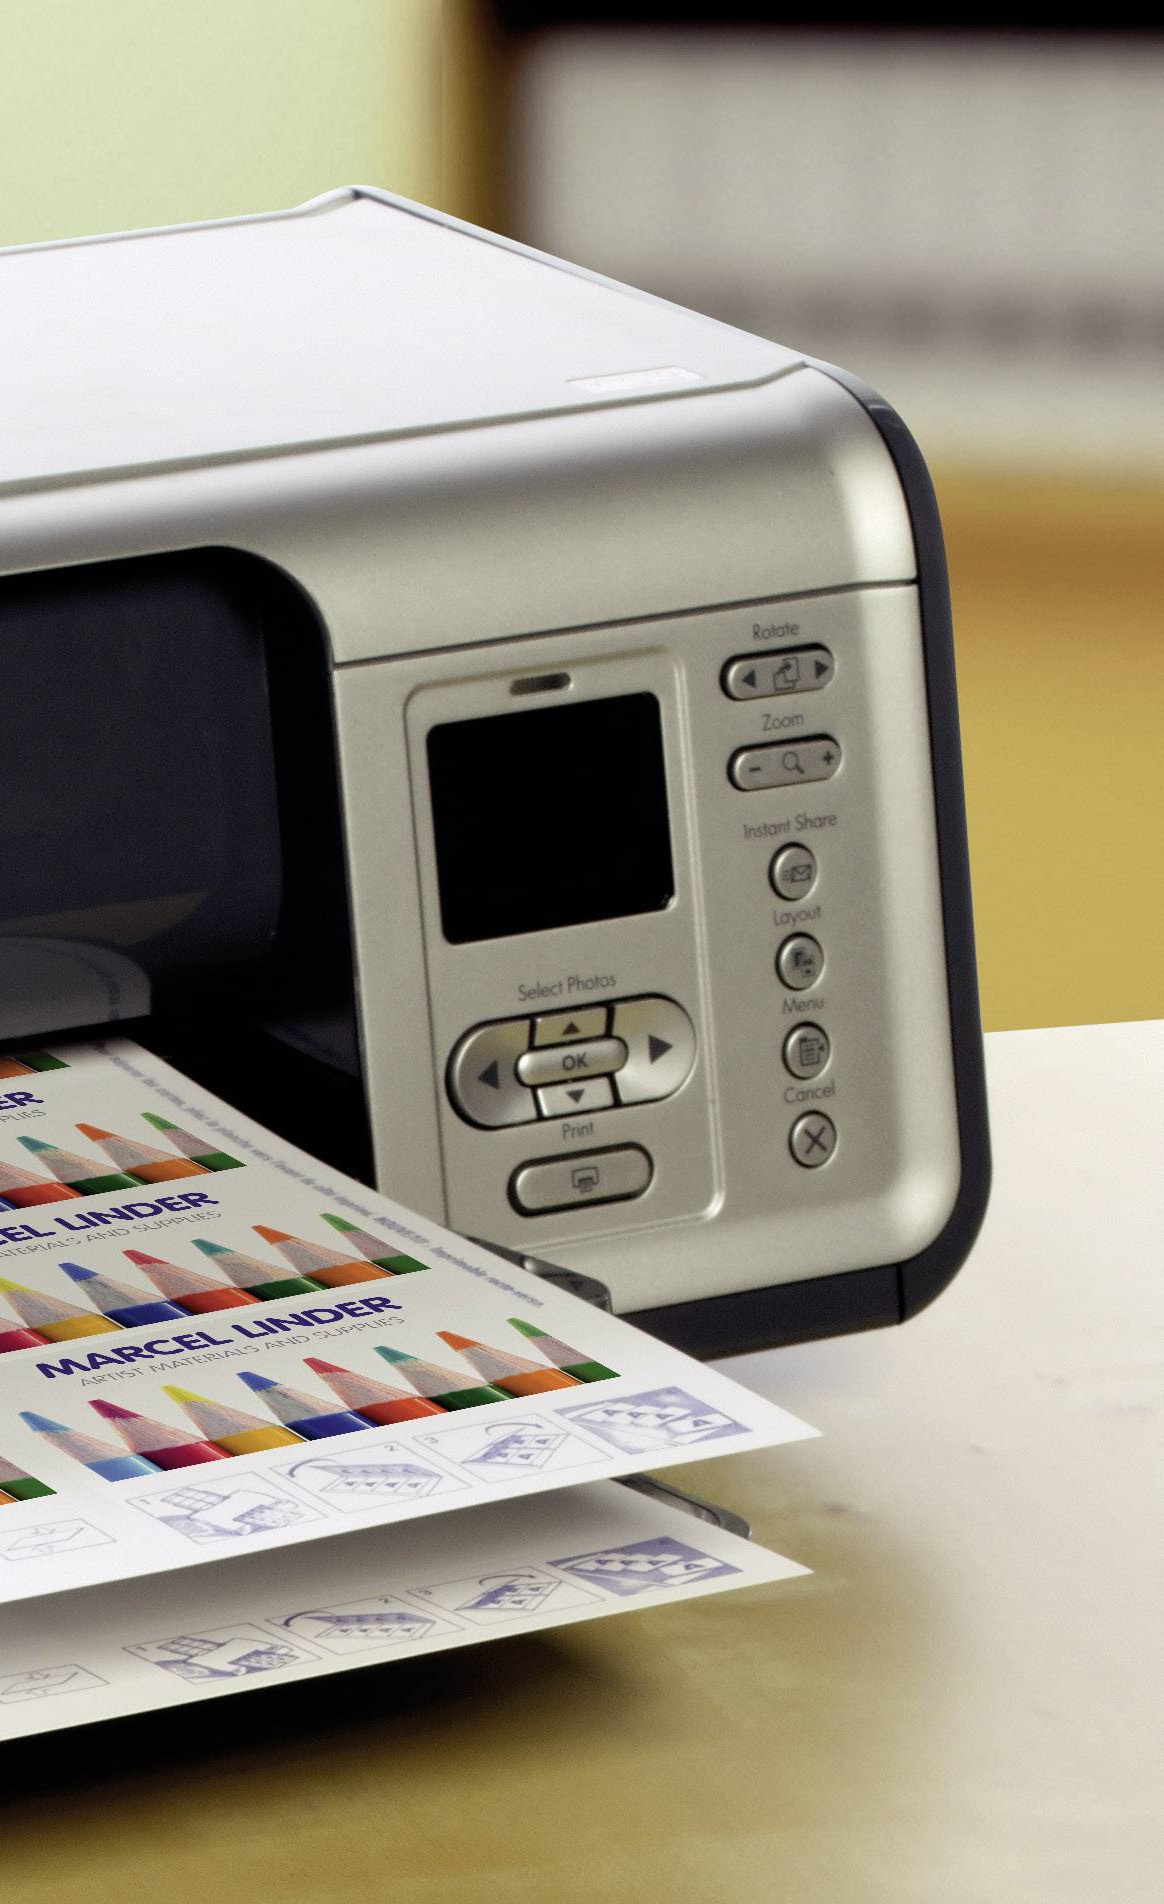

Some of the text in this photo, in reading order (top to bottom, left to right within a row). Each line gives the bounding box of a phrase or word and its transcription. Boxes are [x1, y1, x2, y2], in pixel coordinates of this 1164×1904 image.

[752, 623, 799, 640] Rotate
[762, 714, 804, 731] Zoom
[743, 813, 838, 838] Instant Share
[773, 906, 820, 926] Layout
[519, 975, 616, 1000] Select Photos
[782, 998, 824, 1015] Menu
[562, 1053, 588, 1070] OK
[784, 1080, 835, 1103] Cancel
[563, 1123, 594, 1139] Print
[54, 1191, 219, 1230] LINDER
[87, 1228, 130, 1242] AND
[137, 1211, 221, 1233] SUPPLIES
[36, 1297, 402, 1378] MARCEL LINDER
[81, 1316, 404, 1386] ARTIST MATERIALS AND SUPPLIES
